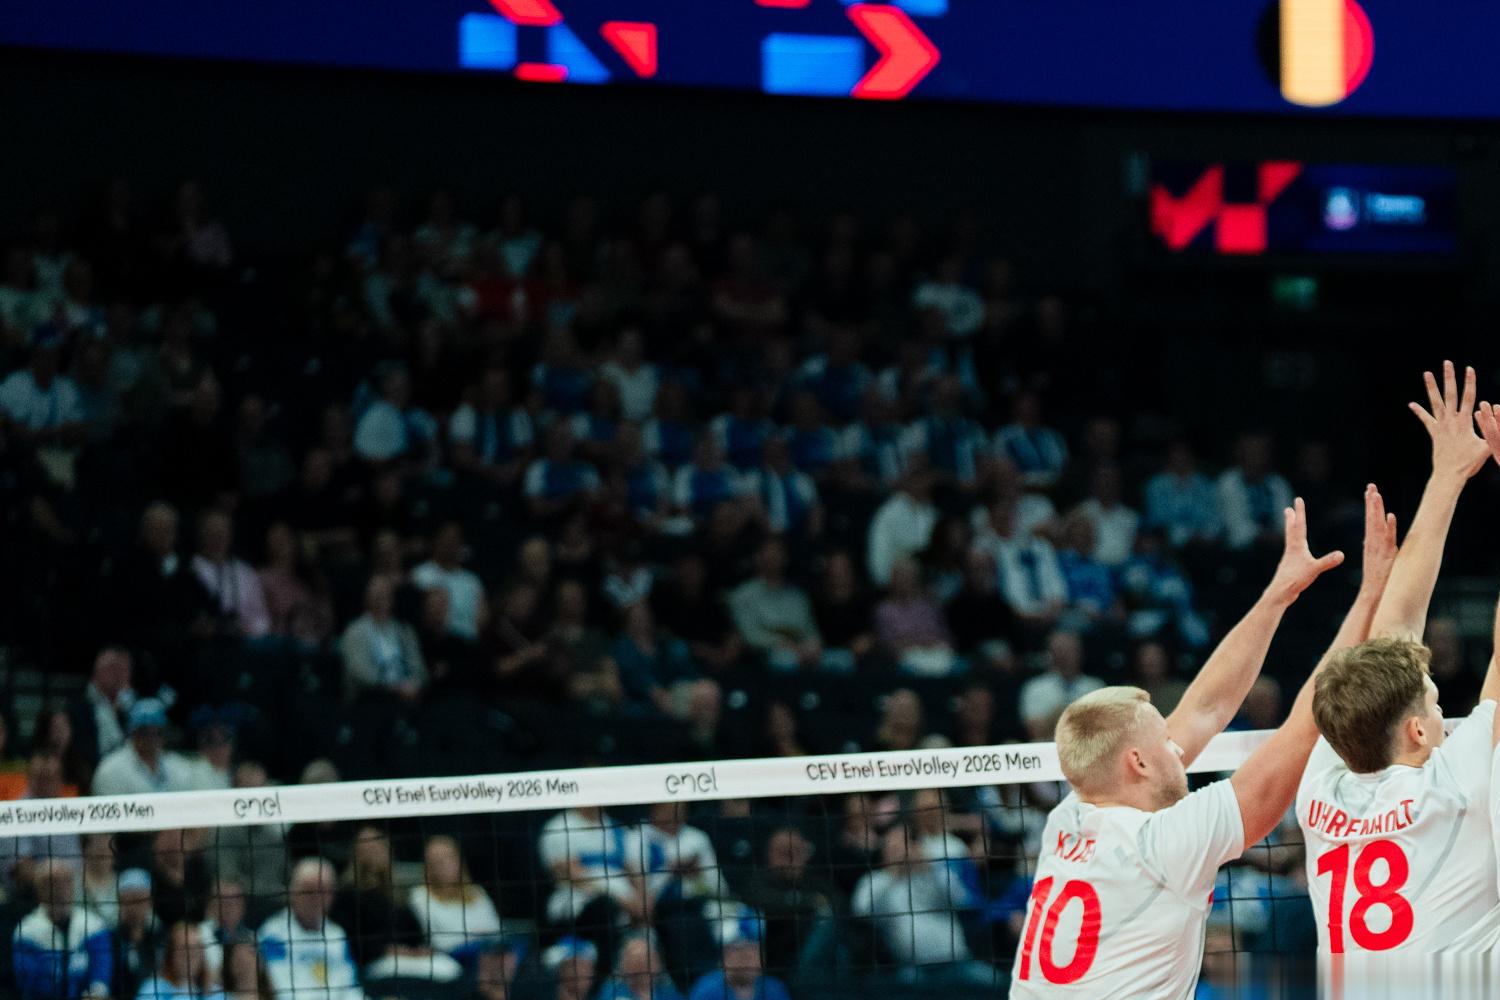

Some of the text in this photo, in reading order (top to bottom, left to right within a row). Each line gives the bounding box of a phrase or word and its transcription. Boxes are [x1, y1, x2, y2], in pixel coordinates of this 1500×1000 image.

[806, 752, 1041, 781] CEV Enel EuroVolley 2026 Men
[362, 778, 579, 806] CEV Enel EuroVolley 2026 Men
[665, 767, 717, 795] enel
[16, 804, 85, 826] EuroVolley
[88, 802, 121, 821] 2026
[124, 800, 155, 818] Men
[233, 792, 282, 819] enel
[1316, 839, 1415, 954] 18
[1019, 876, 1103, 985] 10
